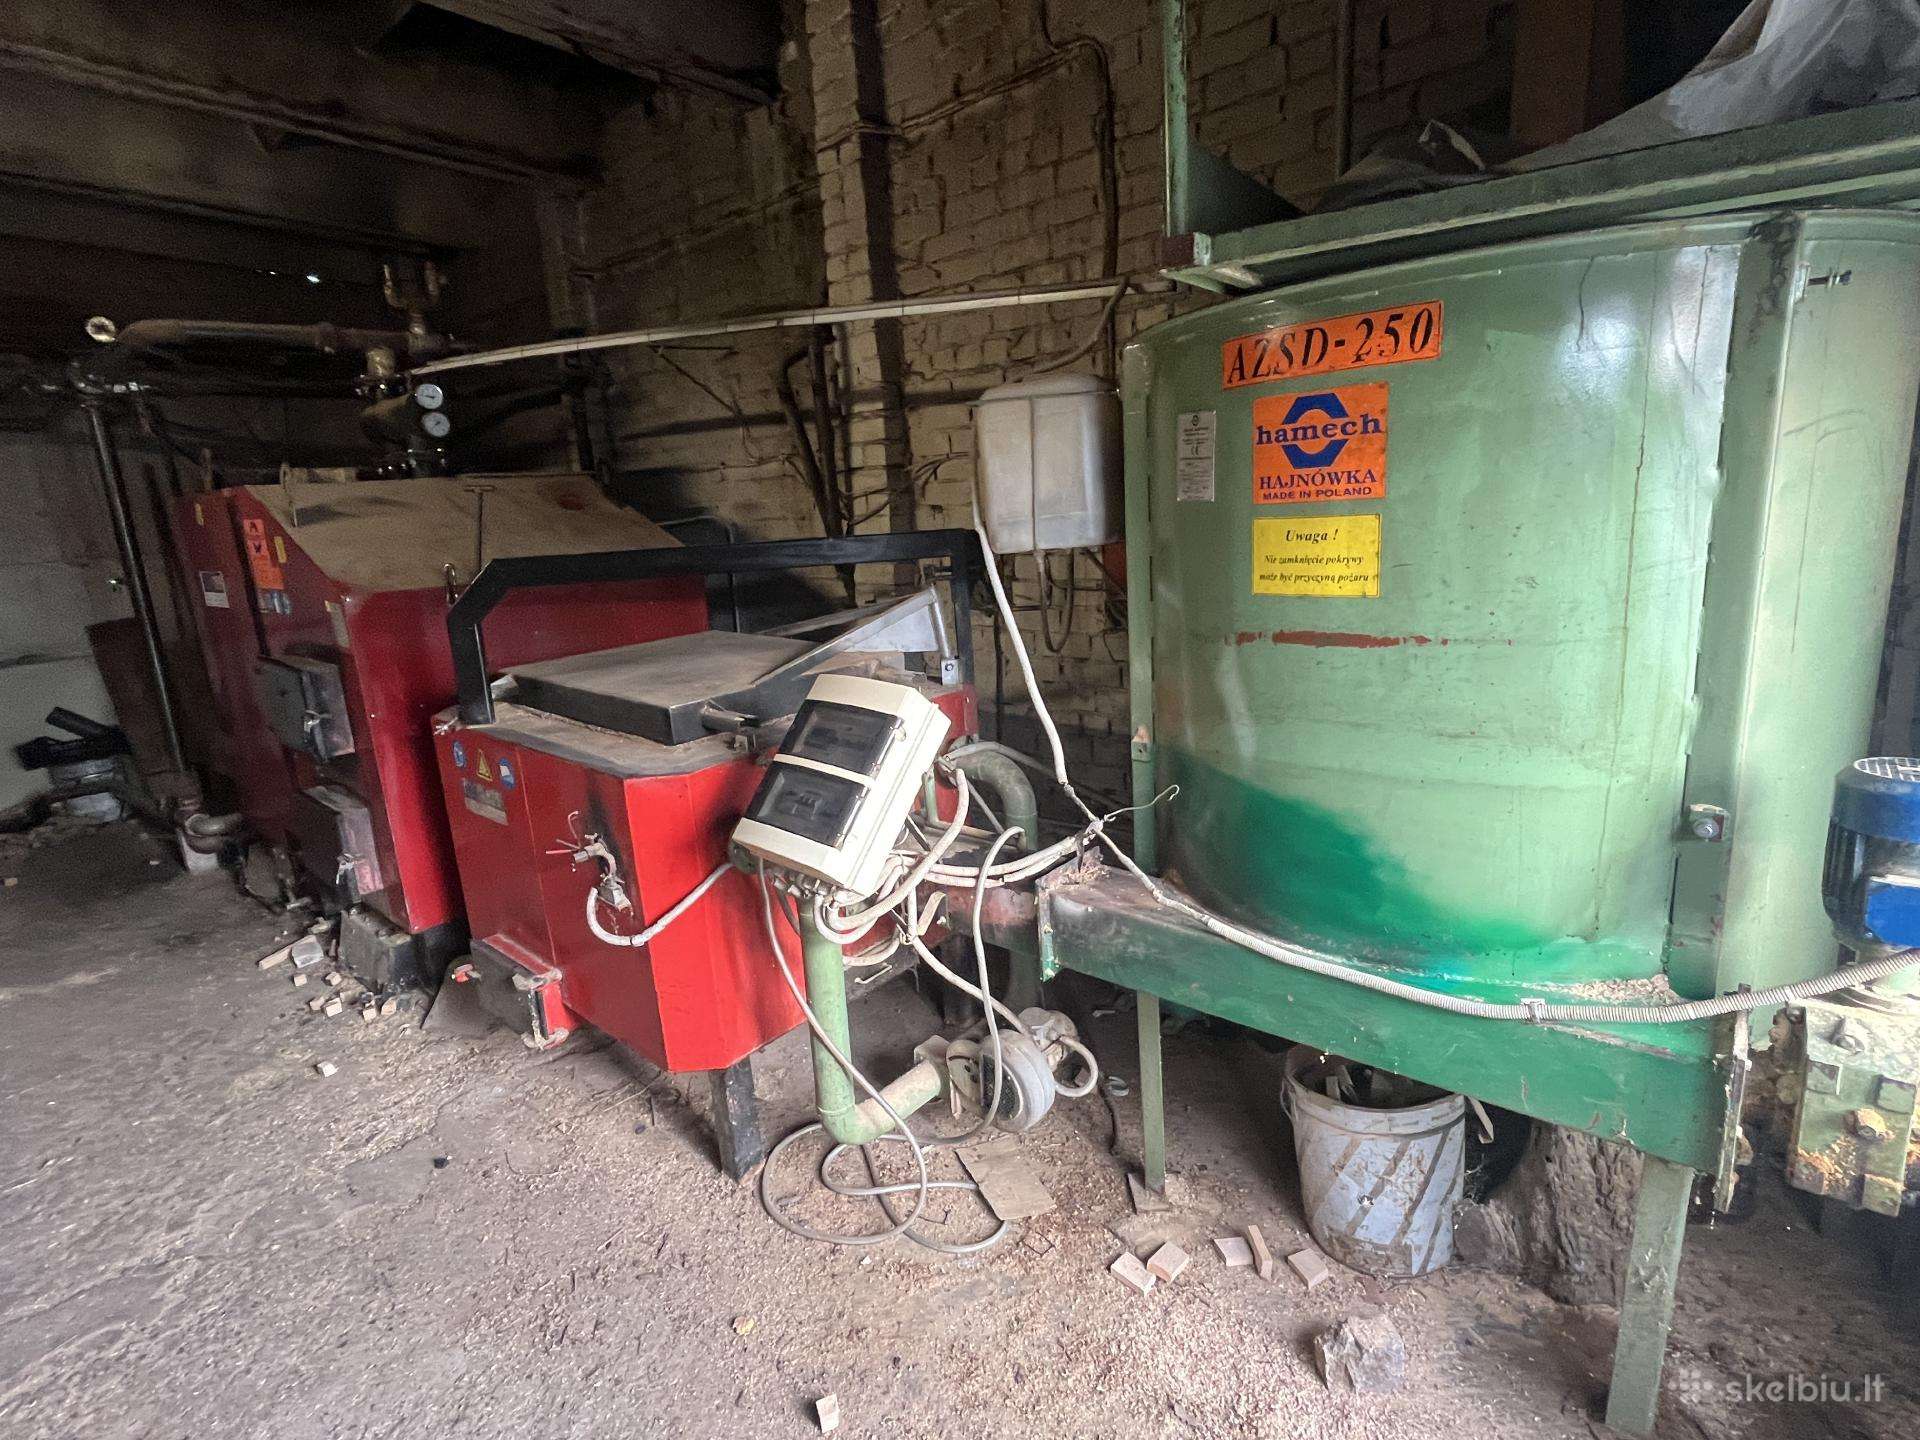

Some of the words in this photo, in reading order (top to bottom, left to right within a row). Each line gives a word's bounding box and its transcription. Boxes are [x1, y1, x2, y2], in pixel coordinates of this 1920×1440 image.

[1227, 307, 1433, 384] AZSD-250
[1256, 413, 1382, 446] hamech
[1260, 468, 1377, 490] HAJNÓWKA
[1263, 490, 1296, 500] MADE
[1299, 490, 1312, 499] IN
[1316, 486, 1372, 498] POLAND
[1286, 530, 1328, 545] Uwaga
